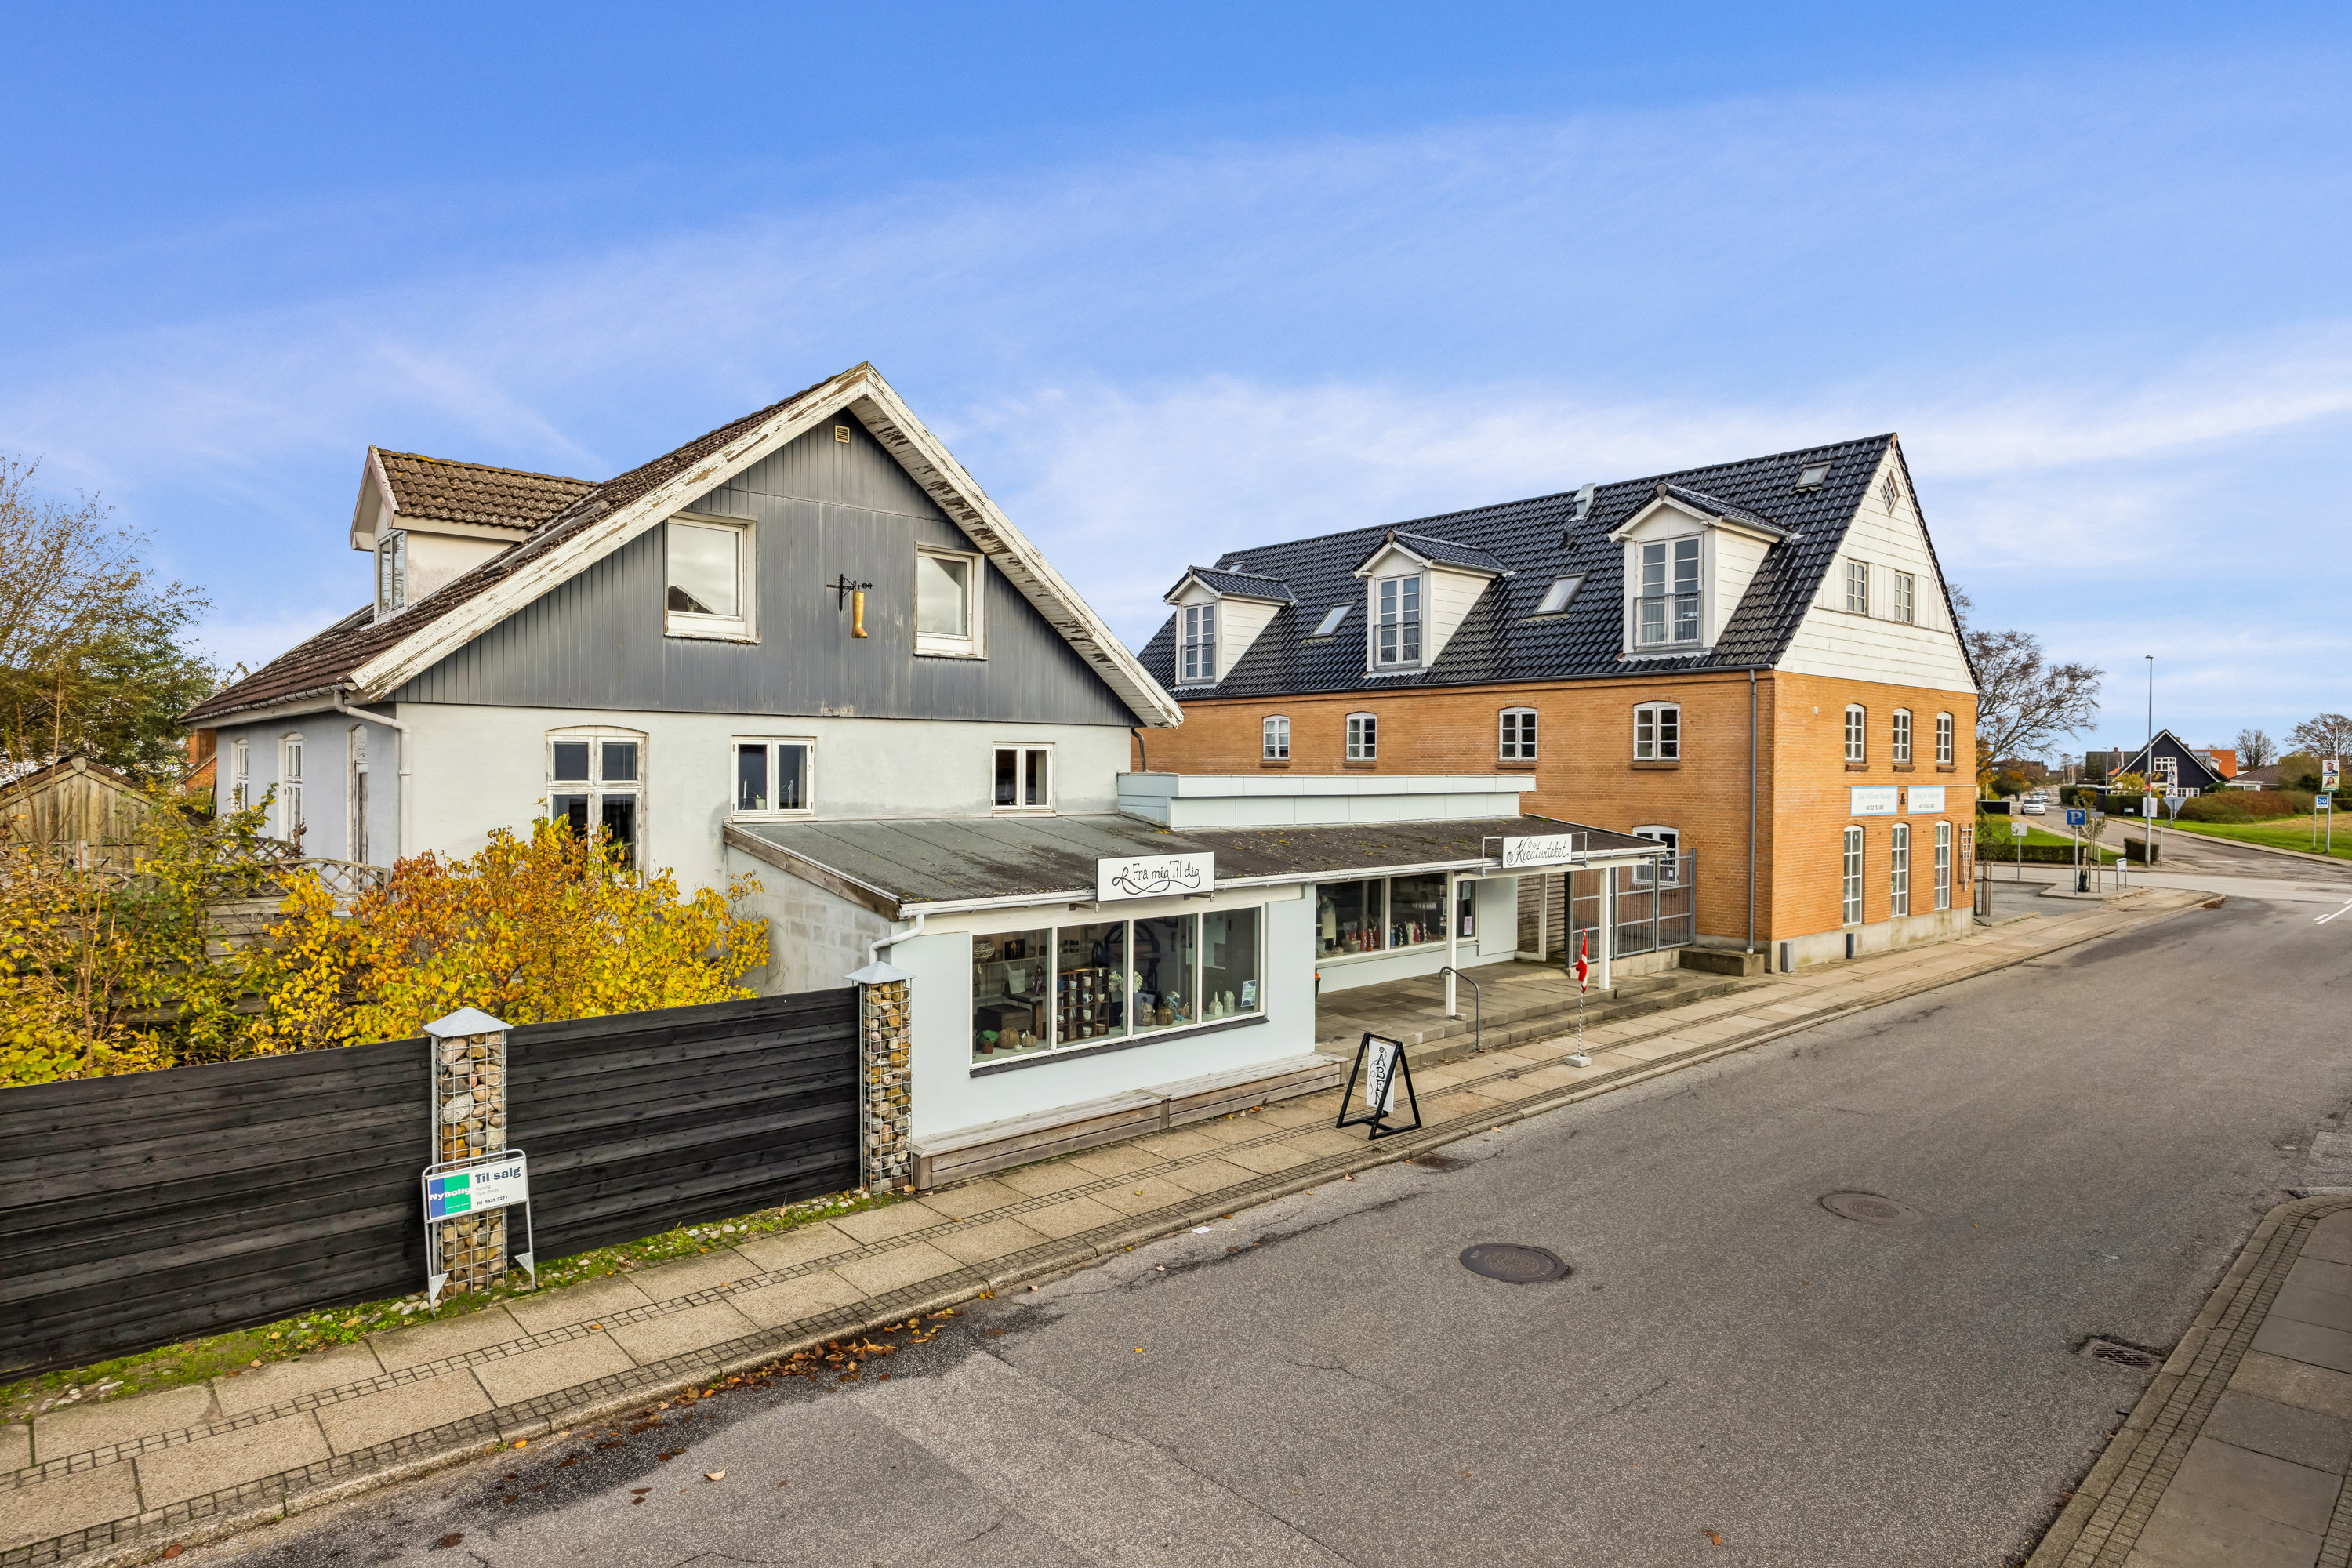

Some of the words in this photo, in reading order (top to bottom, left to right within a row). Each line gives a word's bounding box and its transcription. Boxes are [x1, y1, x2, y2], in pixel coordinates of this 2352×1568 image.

[1900, 793, 1906, 805] &
[2070, 811, 2082, 823] P
[1133, 863, 1149, 880] Fra
[1151, 867, 1171, 884] mig
[1170, 860, 1182, 878] Til
[1185, 861, 1200, 884] dig
[475, 1172, 490, 1184] Til
[493, 1166, 521, 1178] salg
[430, 1187, 470, 1201] Nybolig
